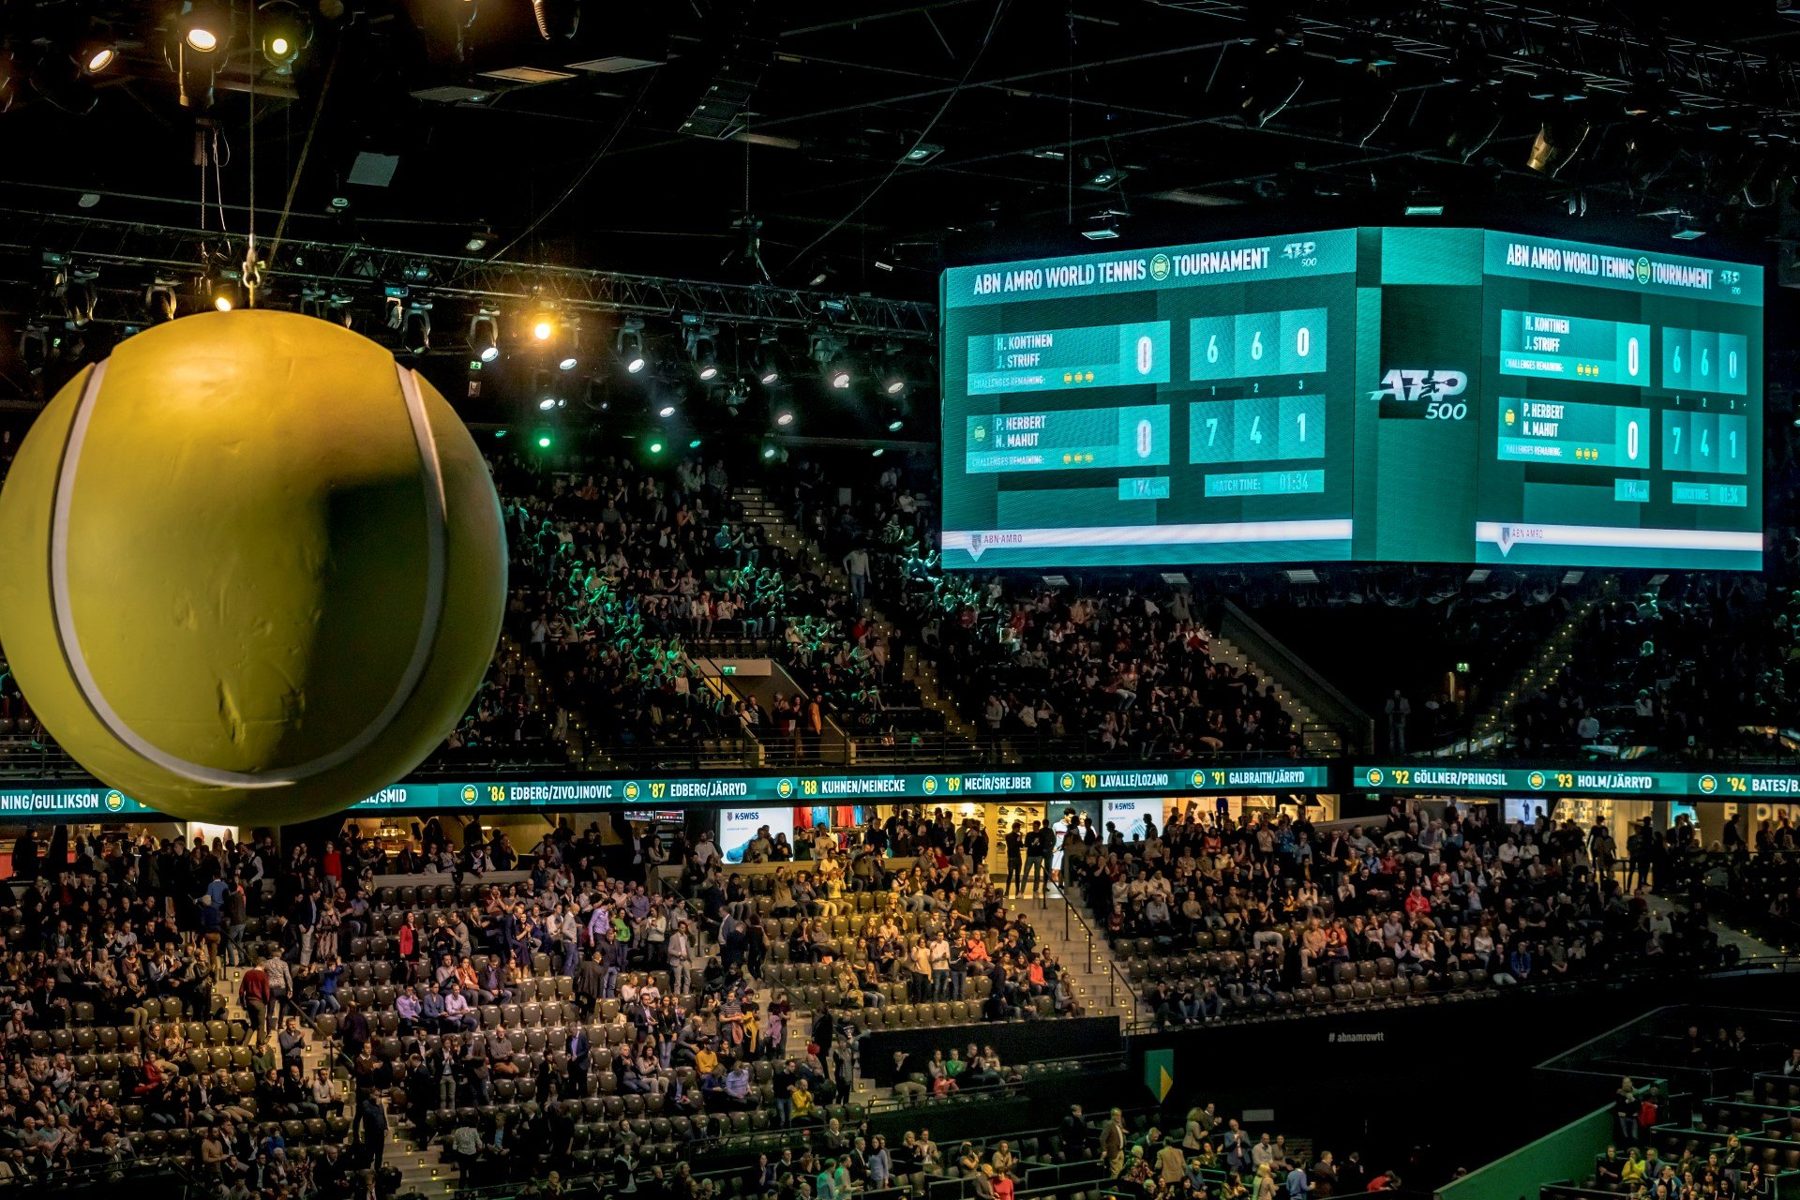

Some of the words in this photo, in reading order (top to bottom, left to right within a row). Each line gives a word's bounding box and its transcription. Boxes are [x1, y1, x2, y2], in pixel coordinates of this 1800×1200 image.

[973, 273, 1001, 295] ABN
[1004, 268, 1043, 292] AMRO
[1045, 264, 1095, 289] WORLD
[1098, 259, 1147, 283] TENNIS
[1173, 247, 1270, 277] TOURNAMENT
[1301, 257, 1317, 267] 500
[1506, 243, 1530, 267] ABN
[1531, 246, 1561, 271] AMRO
[1562, 250, 1599, 276] WORLD
[1600, 255, 1635, 280] TENNIS
[1651, 261, 1713, 290] TOURNAMENT
[1525, 315, 1534, 331] H.
[1534, 316, 1570, 334] KONTINEN
[997, 336, 1007, 351] H.
[1008, 333, 1053, 350] KONTINEN
[1207, 335, 1219, 363] 6
[1251, 331, 1263, 360] 6
[1296, 327, 1310, 357] 0
[1525, 335, 1533, 350] J.
[1533, 336, 1560, 353] STRUFF
[997, 355, 1006, 369] J.
[1007, 353, 1040, 369] STRUFF
[1137, 336, 1152, 375] 0
[1628, 337, 1639, 377] 0
[1673, 345, 1681, 374] 6
[1701, 348, 1709, 376] 6
[1729, 351, 1737, 379] 0
[1212, 386, 1216, 395] 1
[1253, 383, 1259, 393] 2
[1298, 380, 1304, 390] 3
[1365, 369, 1468, 402] ATP
[1425, 402, 1467, 420] 500
[1523, 402, 1531, 418] P.
[1531, 403, 1565, 420] HERBERT
[995, 418, 1004, 431] P.
[1005, 415, 1046, 430] HERBERT
[1206, 418, 1218, 447] 7
[1250, 416, 1262, 444] 4
[1297, 413, 1306, 442] 1
[1523, 421, 1532, 436] N.
[1532, 422, 1559, 438] MAHUT
[995, 435, 1005, 448] N.
[1007, 433, 1039, 448] MAHUT
[1136, 419, 1152, 458] 0
[1627, 421, 1639, 460] 0
[1672, 427, 1681, 454] 7
[1701, 429, 1710, 456] 4
[1729, 431, 1736, 458] 1
[1240, 479, 1261, 490] TIME:
[821, 778, 905, 794] KUHNEN/MEINECKE
[964, 775, 1032, 791] MECÍR/SREJBER
[1100, 773, 1168, 788] LAVALLE/LOZANO
[1229, 769, 1305, 785] GALBRAITH/JÄRRYD
[1414, 769, 1508, 786] GÖLLNER/PRINOSIL
[1577, 773, 1653, 790] HOLM/JÄRRYD
[1752, 778, 1800, 793] BATES/B
[510, 785, 612, 801] EDBERG/ZIVOJINOVIC
[670, 780, 747, 798] EDBERG/JÄRRYD
[1, 793, 99, 811] NING/GULLIKSON
